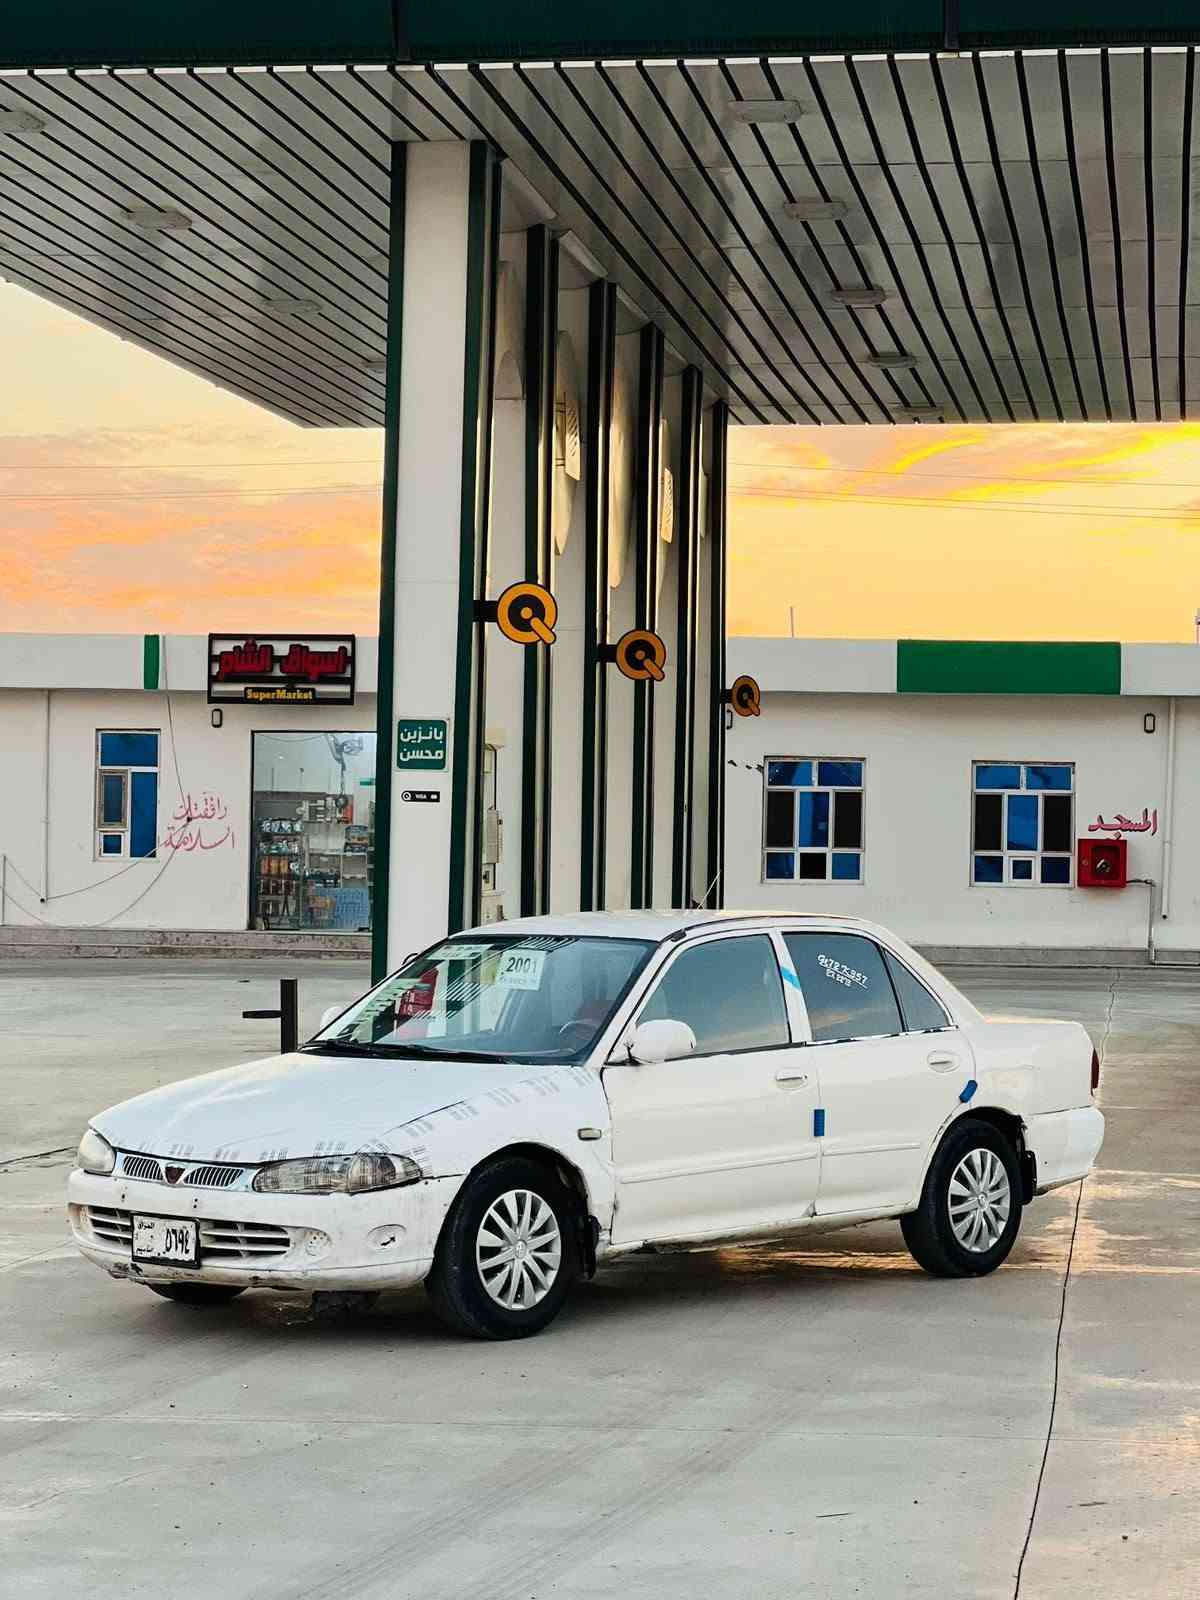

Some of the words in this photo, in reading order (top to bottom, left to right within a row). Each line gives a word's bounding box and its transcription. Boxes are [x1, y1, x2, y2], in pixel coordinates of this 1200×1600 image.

[246, 688, 313, 701] SuperMarket
[400, 726, 443, 743] بانزين
[399, 748, 444, 762] محسن
